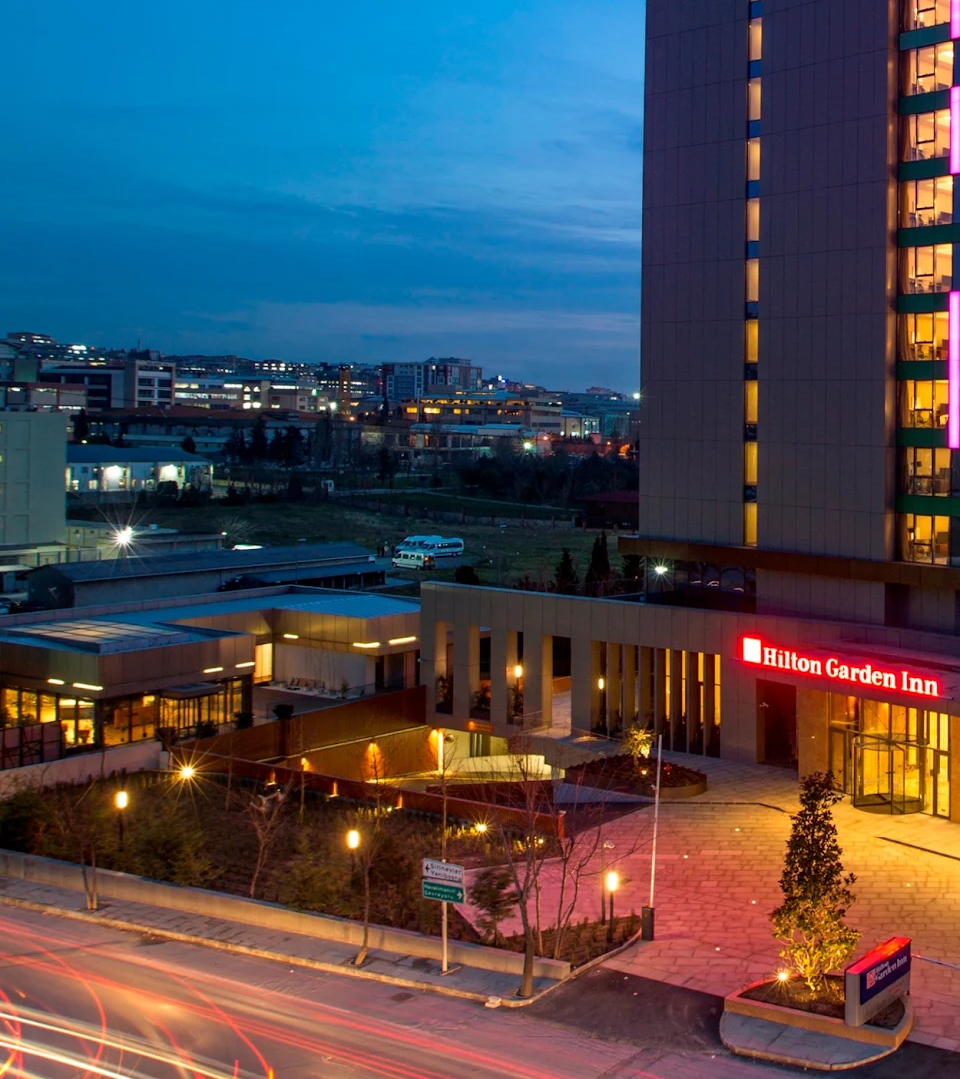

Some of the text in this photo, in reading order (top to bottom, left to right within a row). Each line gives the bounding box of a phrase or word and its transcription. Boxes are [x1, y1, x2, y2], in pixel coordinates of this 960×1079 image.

[763, 647, 939, 697] Hilton Garden Inn
